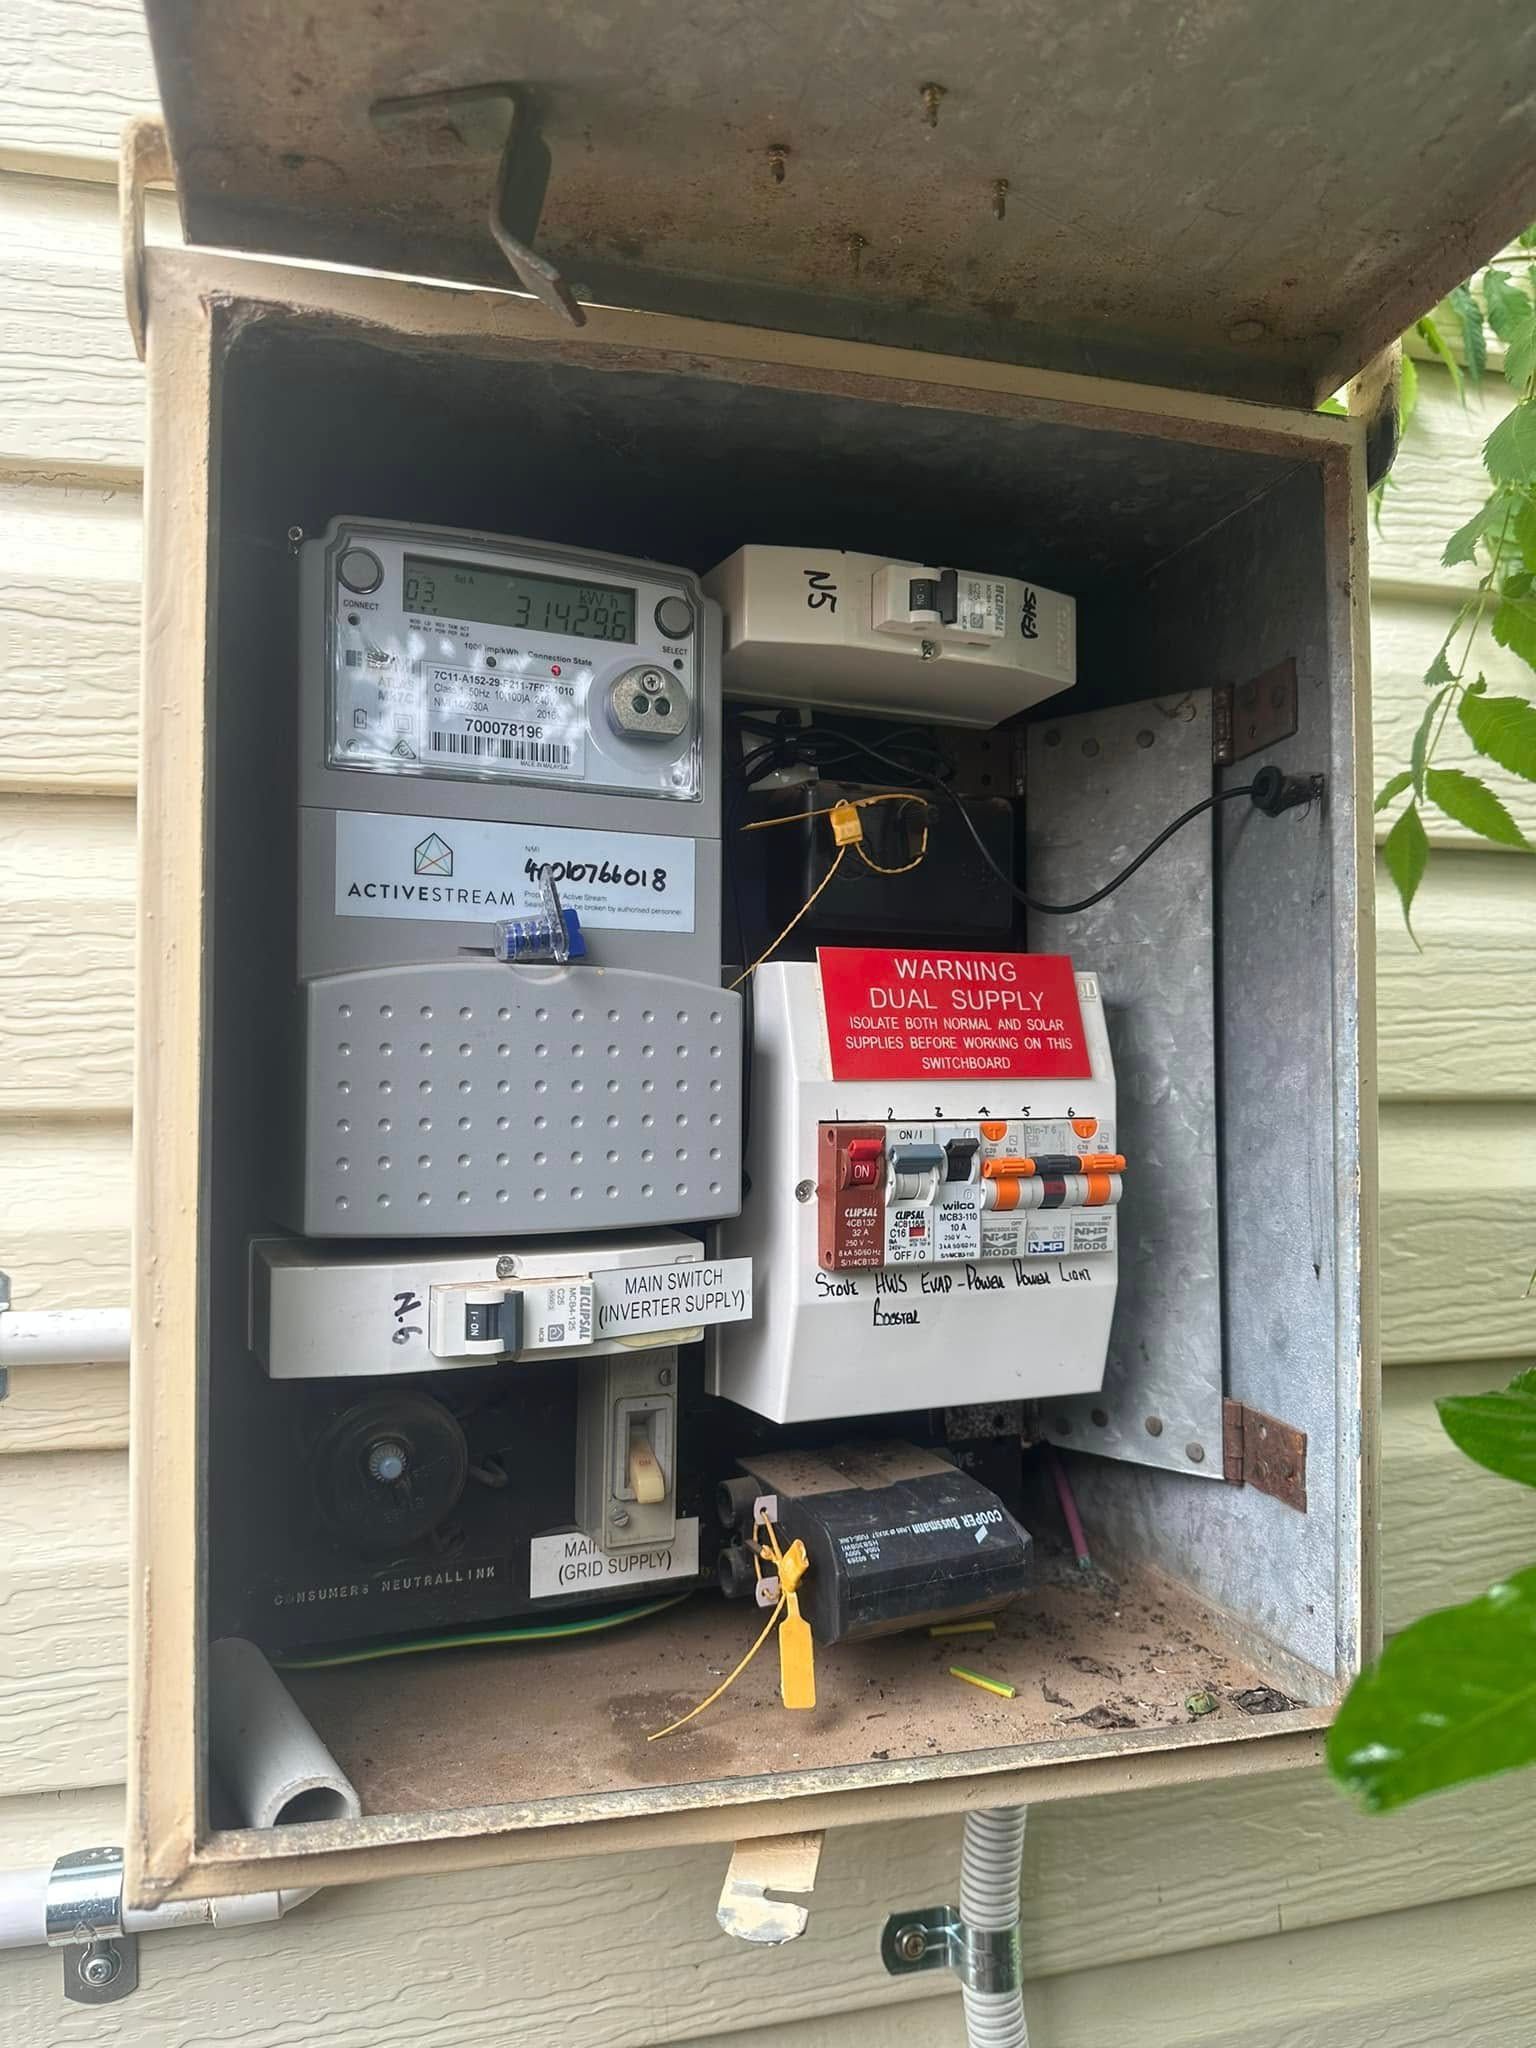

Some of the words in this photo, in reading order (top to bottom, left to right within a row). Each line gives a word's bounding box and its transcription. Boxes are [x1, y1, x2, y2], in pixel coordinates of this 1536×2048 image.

[344, 600, 379, 611] CONNECT
[662, 646, 688, 656] SELECT
[528, 650, 571, 664] Connection
[573, 657, 593, 667] State
[464, 718, 543, 740] 700078196
[347, 882, 516, 906] ACTIVESTREAM
[562, 893, 584, 901] Active
[894, 958, 1018, 983] WARNING
[869, 987, 938, 1010] DUAL
[951, 989, 1044, 1011] SUPPLY
[850, 1016, 900, 1031] ISOLATE
[905, 1017, 938, 1031] BOTH
[943, 1017, 993, 1031] NORMAL
[997, 1018, 1022, 1031] AND
[1027, 1018, 1065, 1032] SOLAR
[845, 1036, 905, 1050] SUPPLIES
[910, 1037, 957, 1050] BEFORE
[963, 1037, 1019, 1050] WORKING
[1024, 1037, 1042, 1050] ON
[1047, 1037, 1073, 1051] THIS
[922, 1056, 1011, 1071] SWITCHBOARD
[887, 1107, 896, 1120] 2
[934, 1106, 944, 1118] 3
[977, 1106, 991, 1117] 4
[1021, 1106, 1031, 1117] 5
[1067, 1106, 1075, 1118] 6
[899, 1130, 913, 1140] ON
[1025, 1126, 1050, 1135] Din-T
[854, 1164, 870, 1179] ON
[942, 1201, 975, 1211] wilco
[844, 1208, 878, 1218] CLIPSAL
[895, 1210, 924, 1220] CLIPSAL
[940, 1213, 978, 1222] MCB3-110
[846, 1219, 876, 1228] 4CB132
[950, 1224, 959, 1232] 10
[960, 1223, 967, 1231] A
[851, 1230, 862, 1238] 32
[889, 1228, 906, 1238] C16
[982, 1232, 1018, 1241] NHP
[1074, 1227, 1108, 1236] NHP
[982, 1248, 1018, 1257] MOD6
[1029, 1242, 1064, 1253] NHP
[1073, 1242, 1108, 1251] MOD6
[894, 1251, 911, 1261] OFF
[840, 1258, 880, 1267] S/1/4CB132
[625, 1275, 663, 1296] MAIN
[667, 1268, 723, 1291] SWITCH
[875, 1272, 908, 1294] HWS
[567, 1287, 577, 1332] MCB4-125
[599, 1297, 681, 1330] (INVERTER
[685, 1289, 745, 1313] SUPPLY)
[579, 1298, 591, 1340] CLIPSAL
[470, 1323, 479, 1336] ON
[961, 1508, 1003, 1528] COOPER
[912, 1516, 961, 1534] Bussmann
[559, 1561, 603, 1586] (GRID
[608, 1551, 672, 1575] SUPPLY)
[273, 1584, 369, 1607] CNSUMERS
